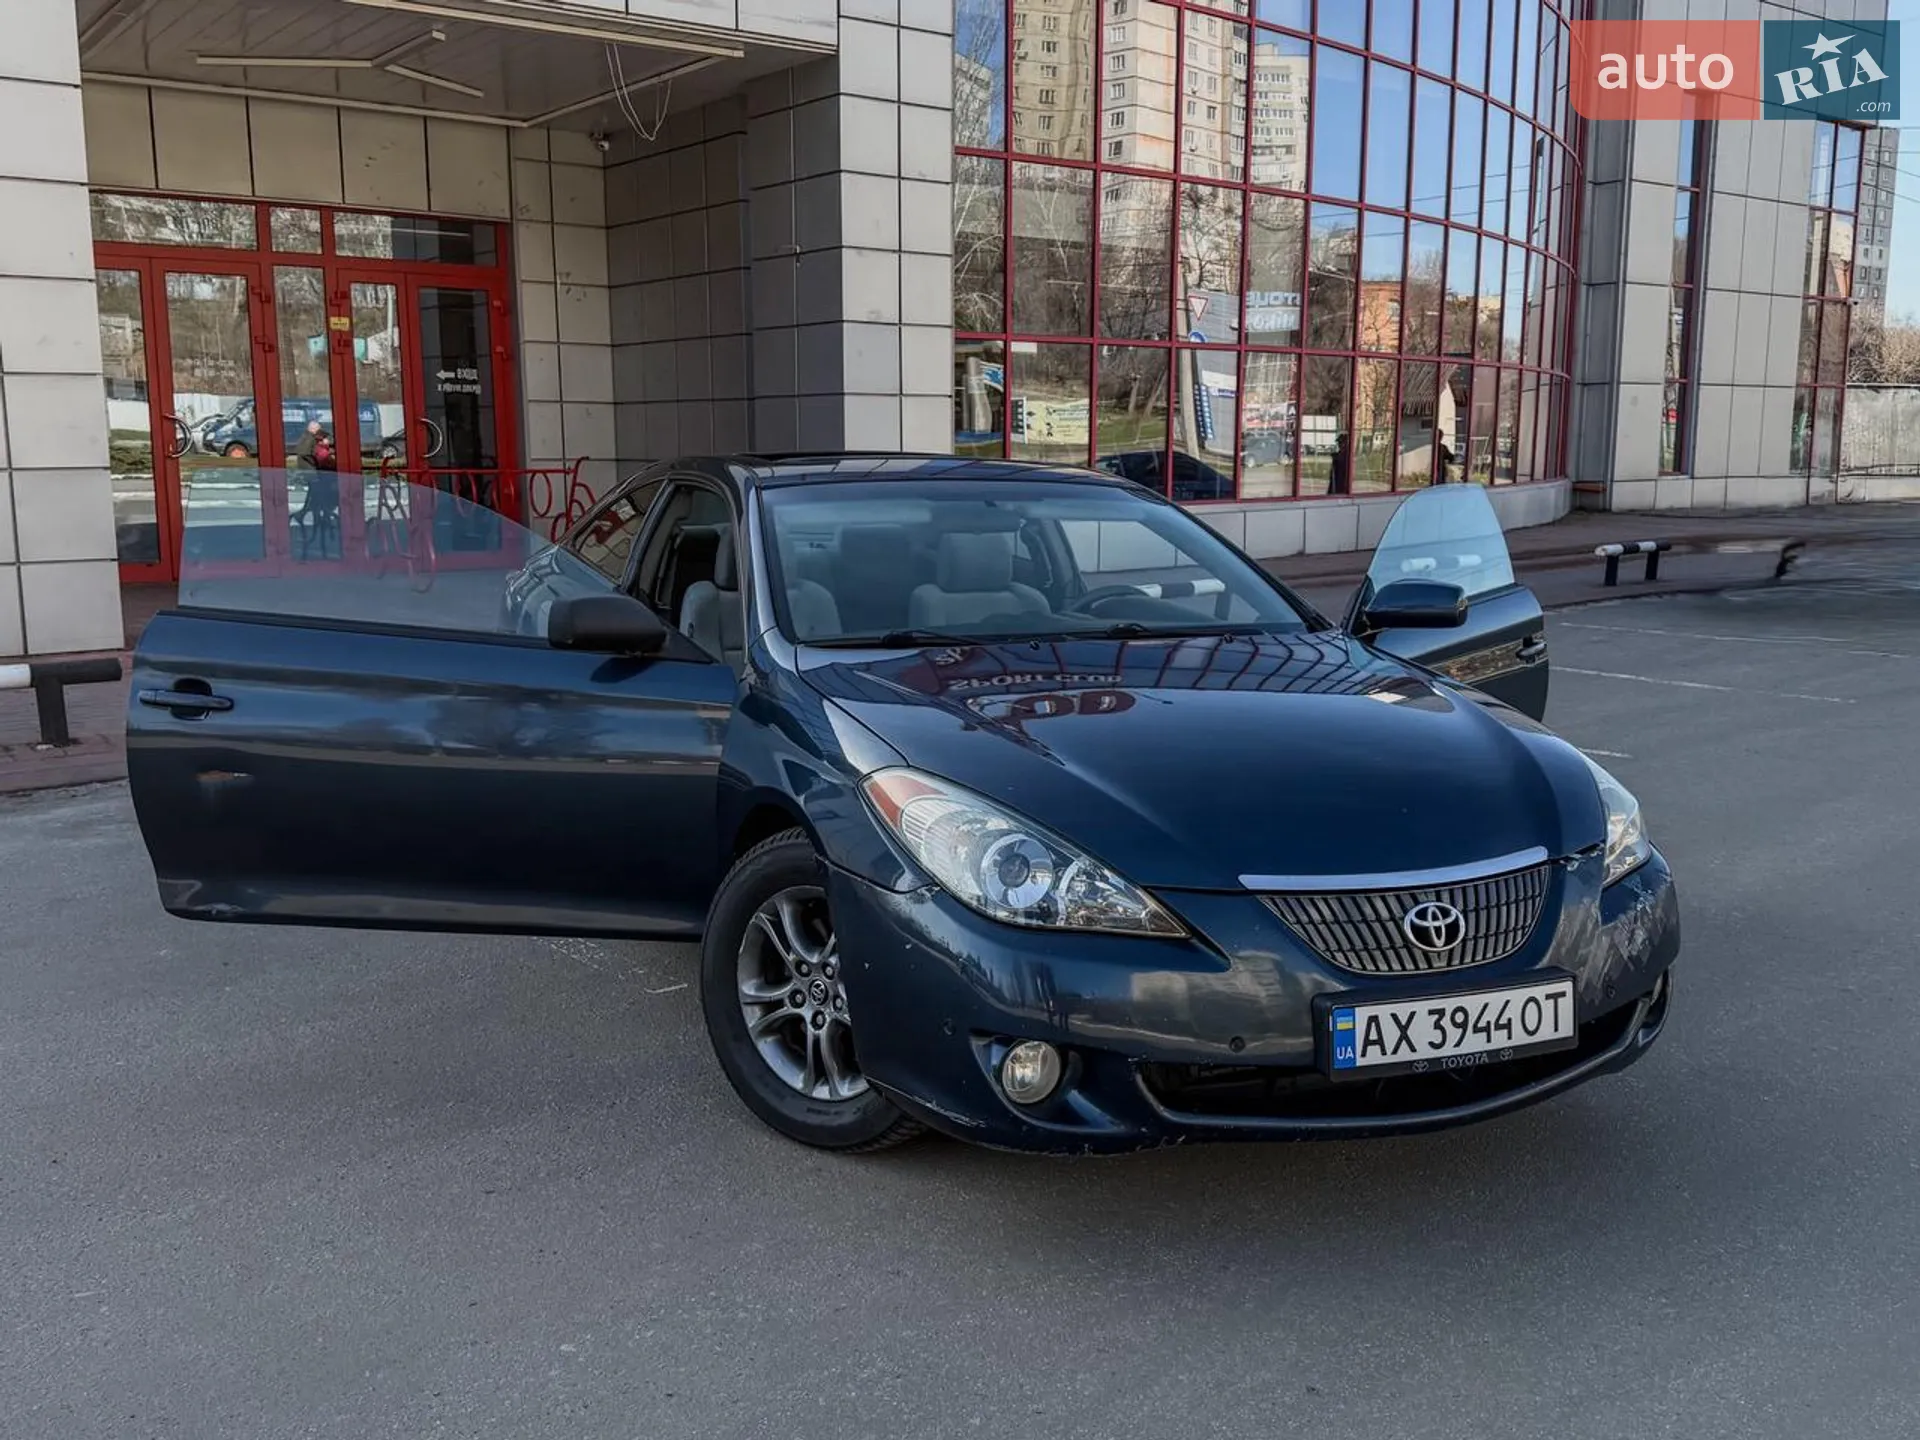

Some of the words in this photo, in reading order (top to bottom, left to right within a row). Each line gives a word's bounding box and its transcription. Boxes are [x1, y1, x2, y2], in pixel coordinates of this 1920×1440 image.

[1360, 1010, 1418, 1058] AX
[1427, 1000, 1513, 1050] 3944
[1521, 991, 1567, 1037] OT
[1336, 1047, 1354, 1060] UA
[1441, 1053, 1489, 1069] TOYOTA
